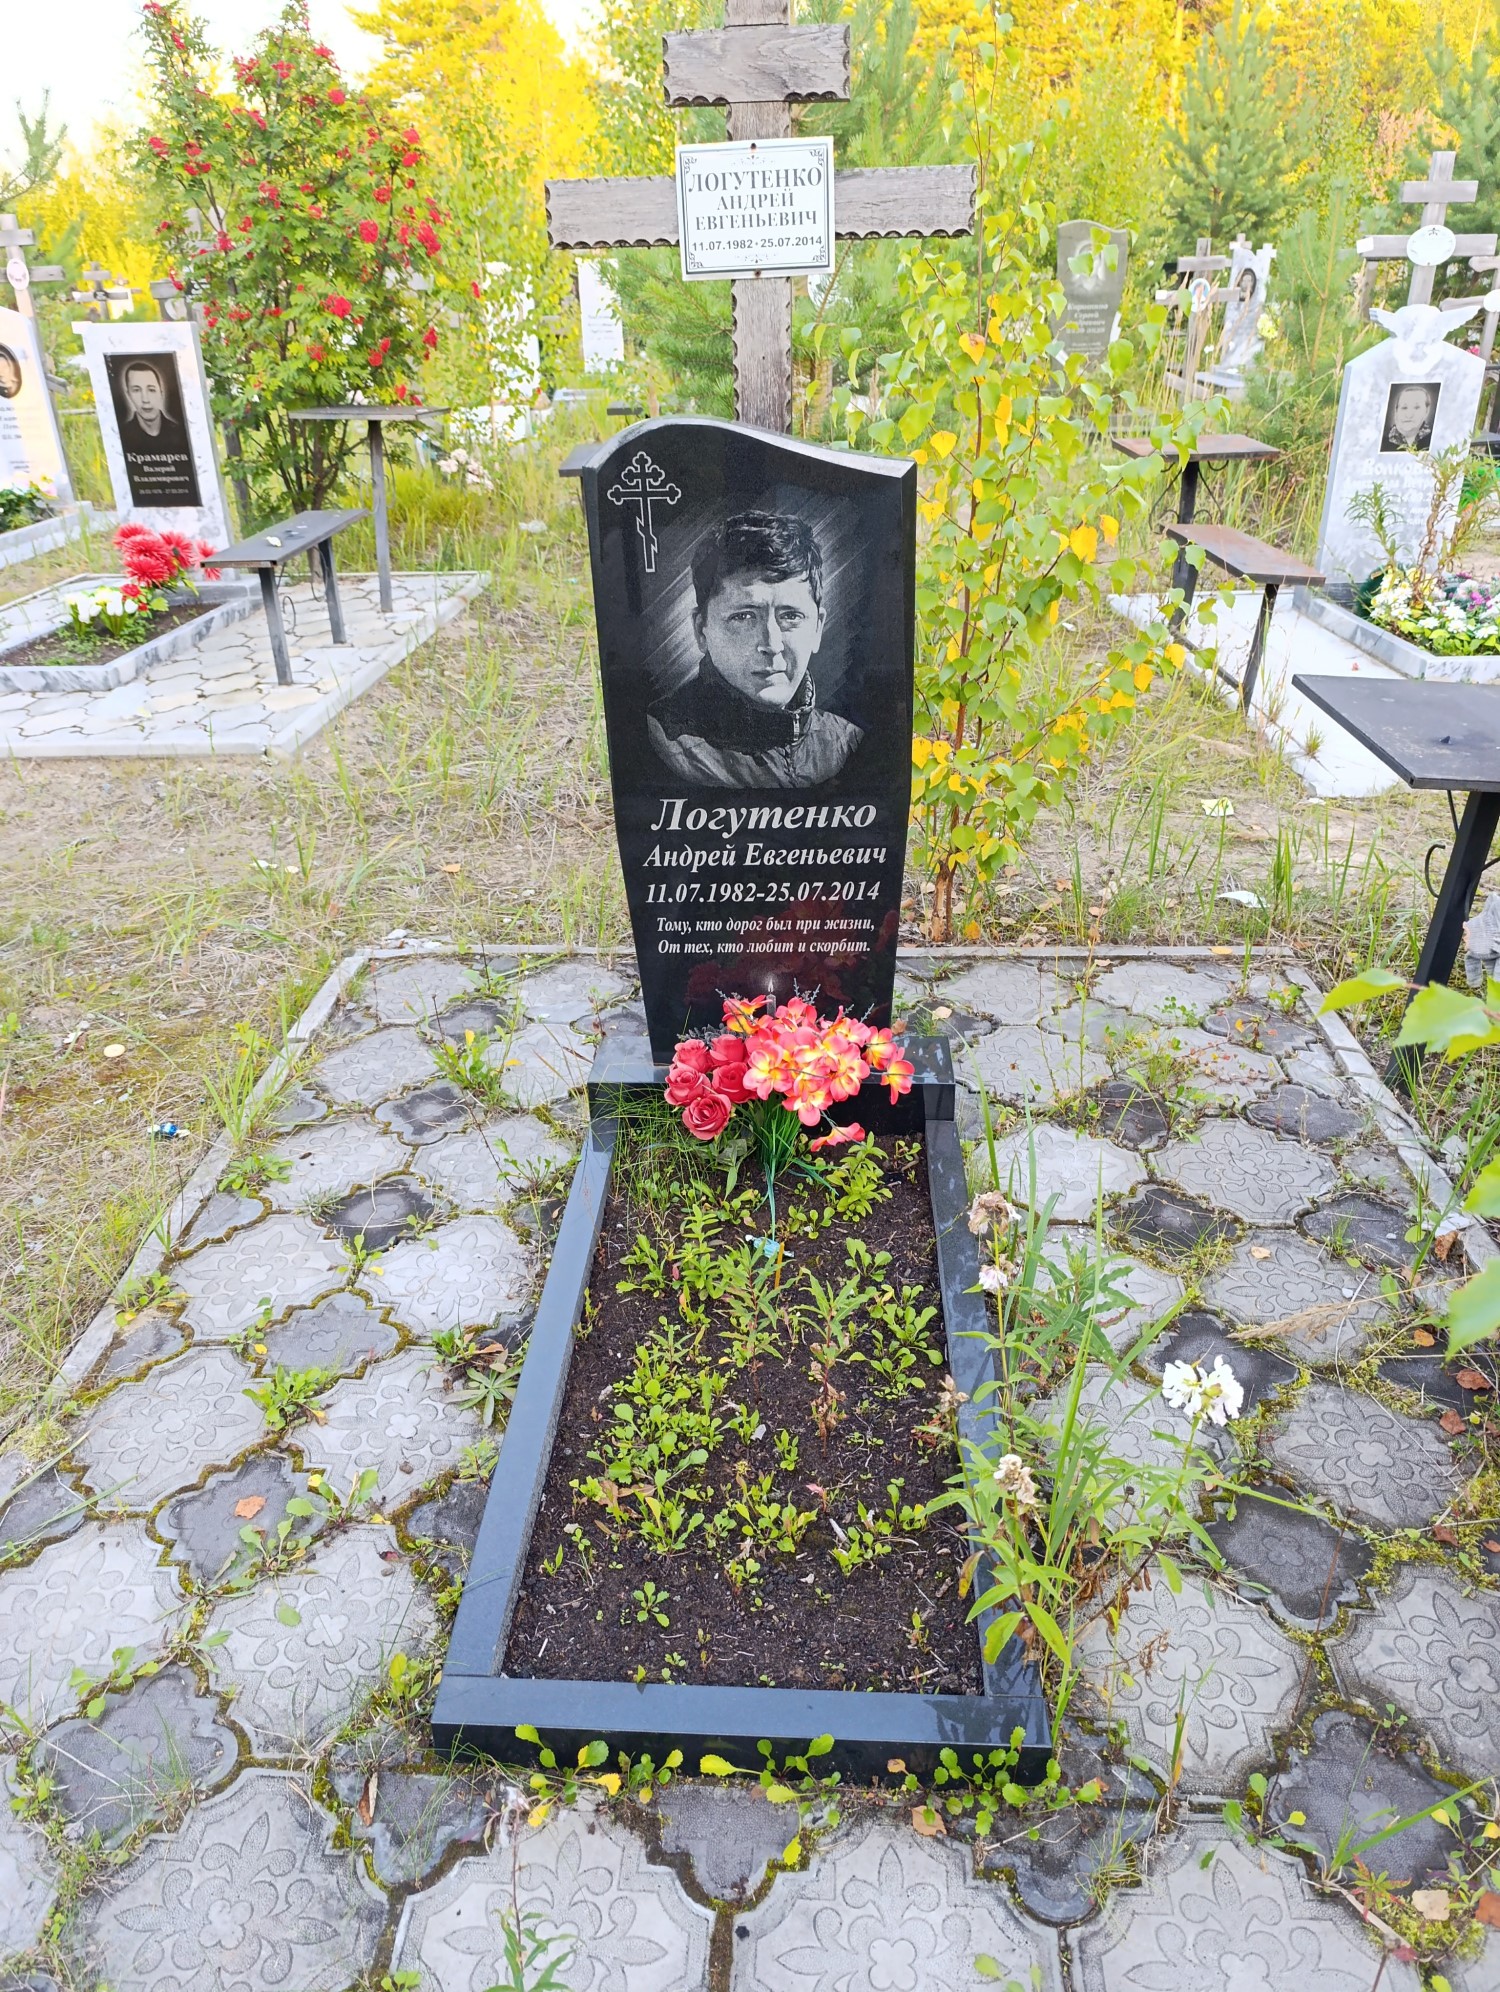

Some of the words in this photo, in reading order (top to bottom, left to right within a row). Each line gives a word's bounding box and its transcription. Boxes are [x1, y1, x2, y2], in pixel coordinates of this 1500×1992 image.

[688, 167, 822, 193] ЛОГУТЕНКО
[717, 188, 794, 211] АНДРЕЙ
[695, 210, 817, 231] ЕВГЕНЬЕВИЧ
[650, 798, 877, 839] Логутенко
[642, 843, 737, 873] Андрей
[742, 842, 887, 867] Евгеньевич
[645, 881, 881, 904] 11.07.1982-25.07.2014
[656, 917, 693, 935] Тому,
[695, 921, 723, 932] кто
[725, 917, 763, 935] дорог
[765, 917, 792, 932] был
[795, 919, 822, 936] при
[824, 918, 875, 933] жизни,
[657, 940, 682, 954] От
[684, 942, 714, 956] тех,
[717, 941, 744, 953] кто
[746, 938, 795, 953] любит
[797, 941, 807, 953] и
[811, 937, 872, 955] скорбит.
